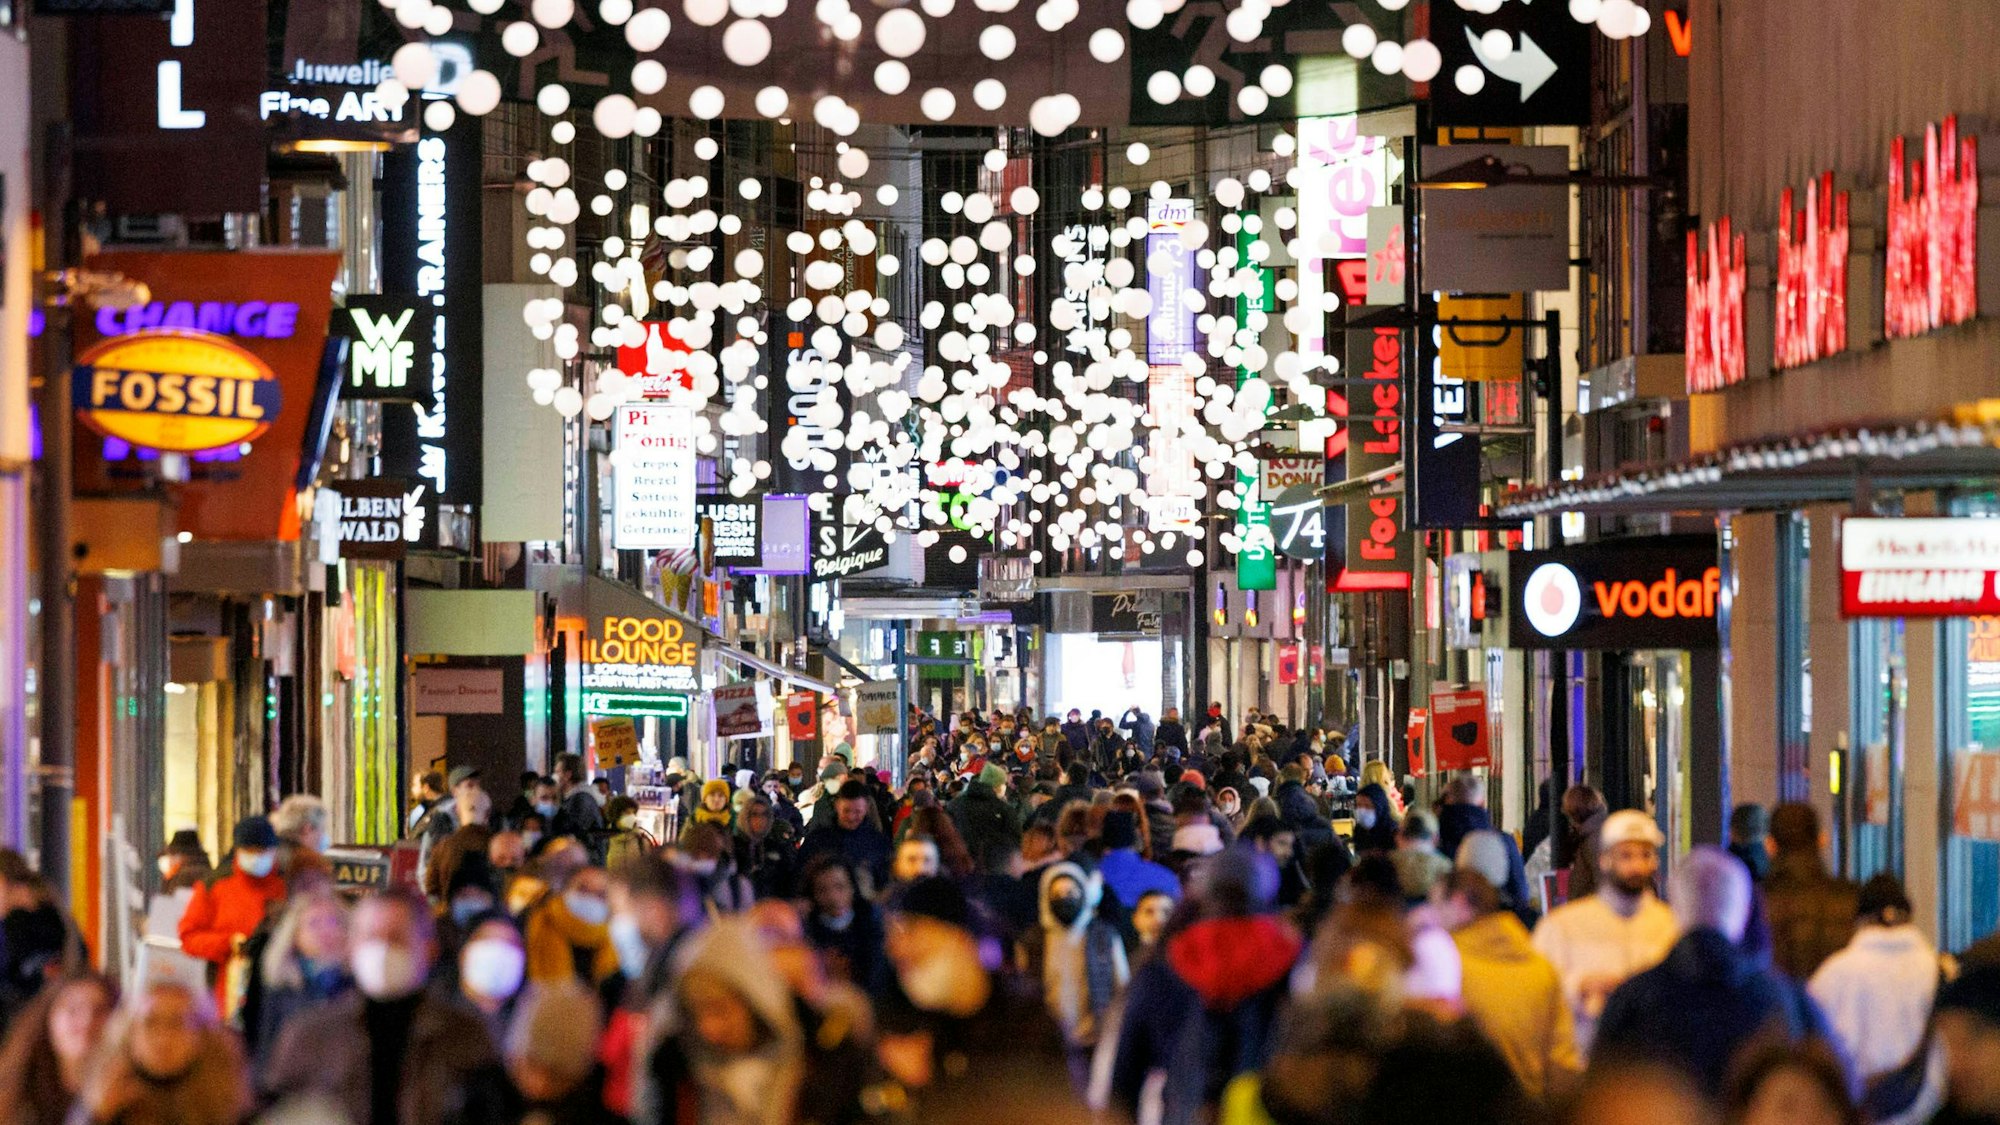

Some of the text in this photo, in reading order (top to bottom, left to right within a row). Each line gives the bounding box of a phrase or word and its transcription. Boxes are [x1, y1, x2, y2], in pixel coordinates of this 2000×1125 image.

[1158, 204, 1187, 220] dm
[91, 370, 265, 420] FOSSIL
[340, 497, 401, 519] LBEN
[815, 548, 884, 577] Belgique
[604, 616, 684, 642] FOOD
[589, 639, 697, 666] LOUNGE
[714, 686, 756, 700] PIZZA
